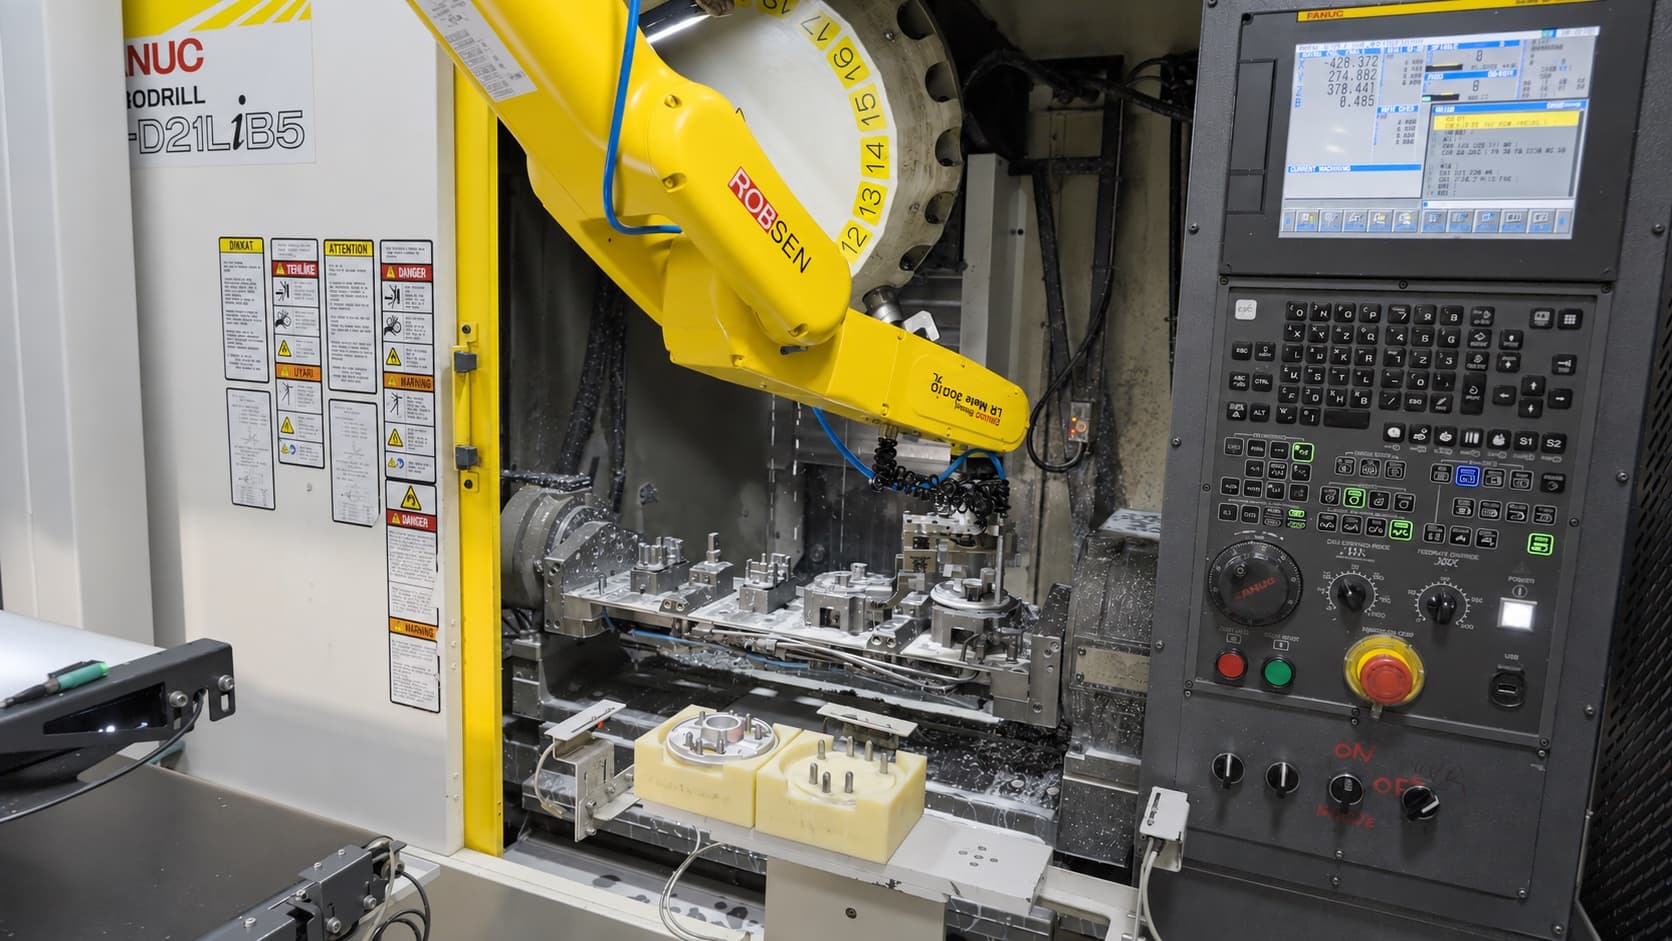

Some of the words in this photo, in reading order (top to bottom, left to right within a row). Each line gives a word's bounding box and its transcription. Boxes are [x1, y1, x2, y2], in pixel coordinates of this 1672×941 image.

[1307, 10, 1344, 19] FANUC
[800, 16, 830, 41] 17
[125, 38, 204, 77] NUC
[833, 47, 861, 80] 16
[1324, 55, 1379, 69] -428.372
[1328, 68, 1377, 83] 274.882
[1327, 82, 1375, 96] 378.441
[855, 93, 880, 126] 15
[1339, 96, 1375, 108] 0.485
[866, 142, 885, 172] 14
[859, 187, 881, 215] 13
[729, 168, 812, 274] ROBSEN
[841, 226, 868, 254] 12
[329, 243, 368, 254] ATTENTION
[398, 267, 426, 278] DANGER
[1519, 437, 1533, 446] S1
[1546, 439, 1562, 448] S2
[402, 514, 429, 529] DANGER
[405, 623, 434, 638] WARNING
[1334, 741, 1377, 763] ON
